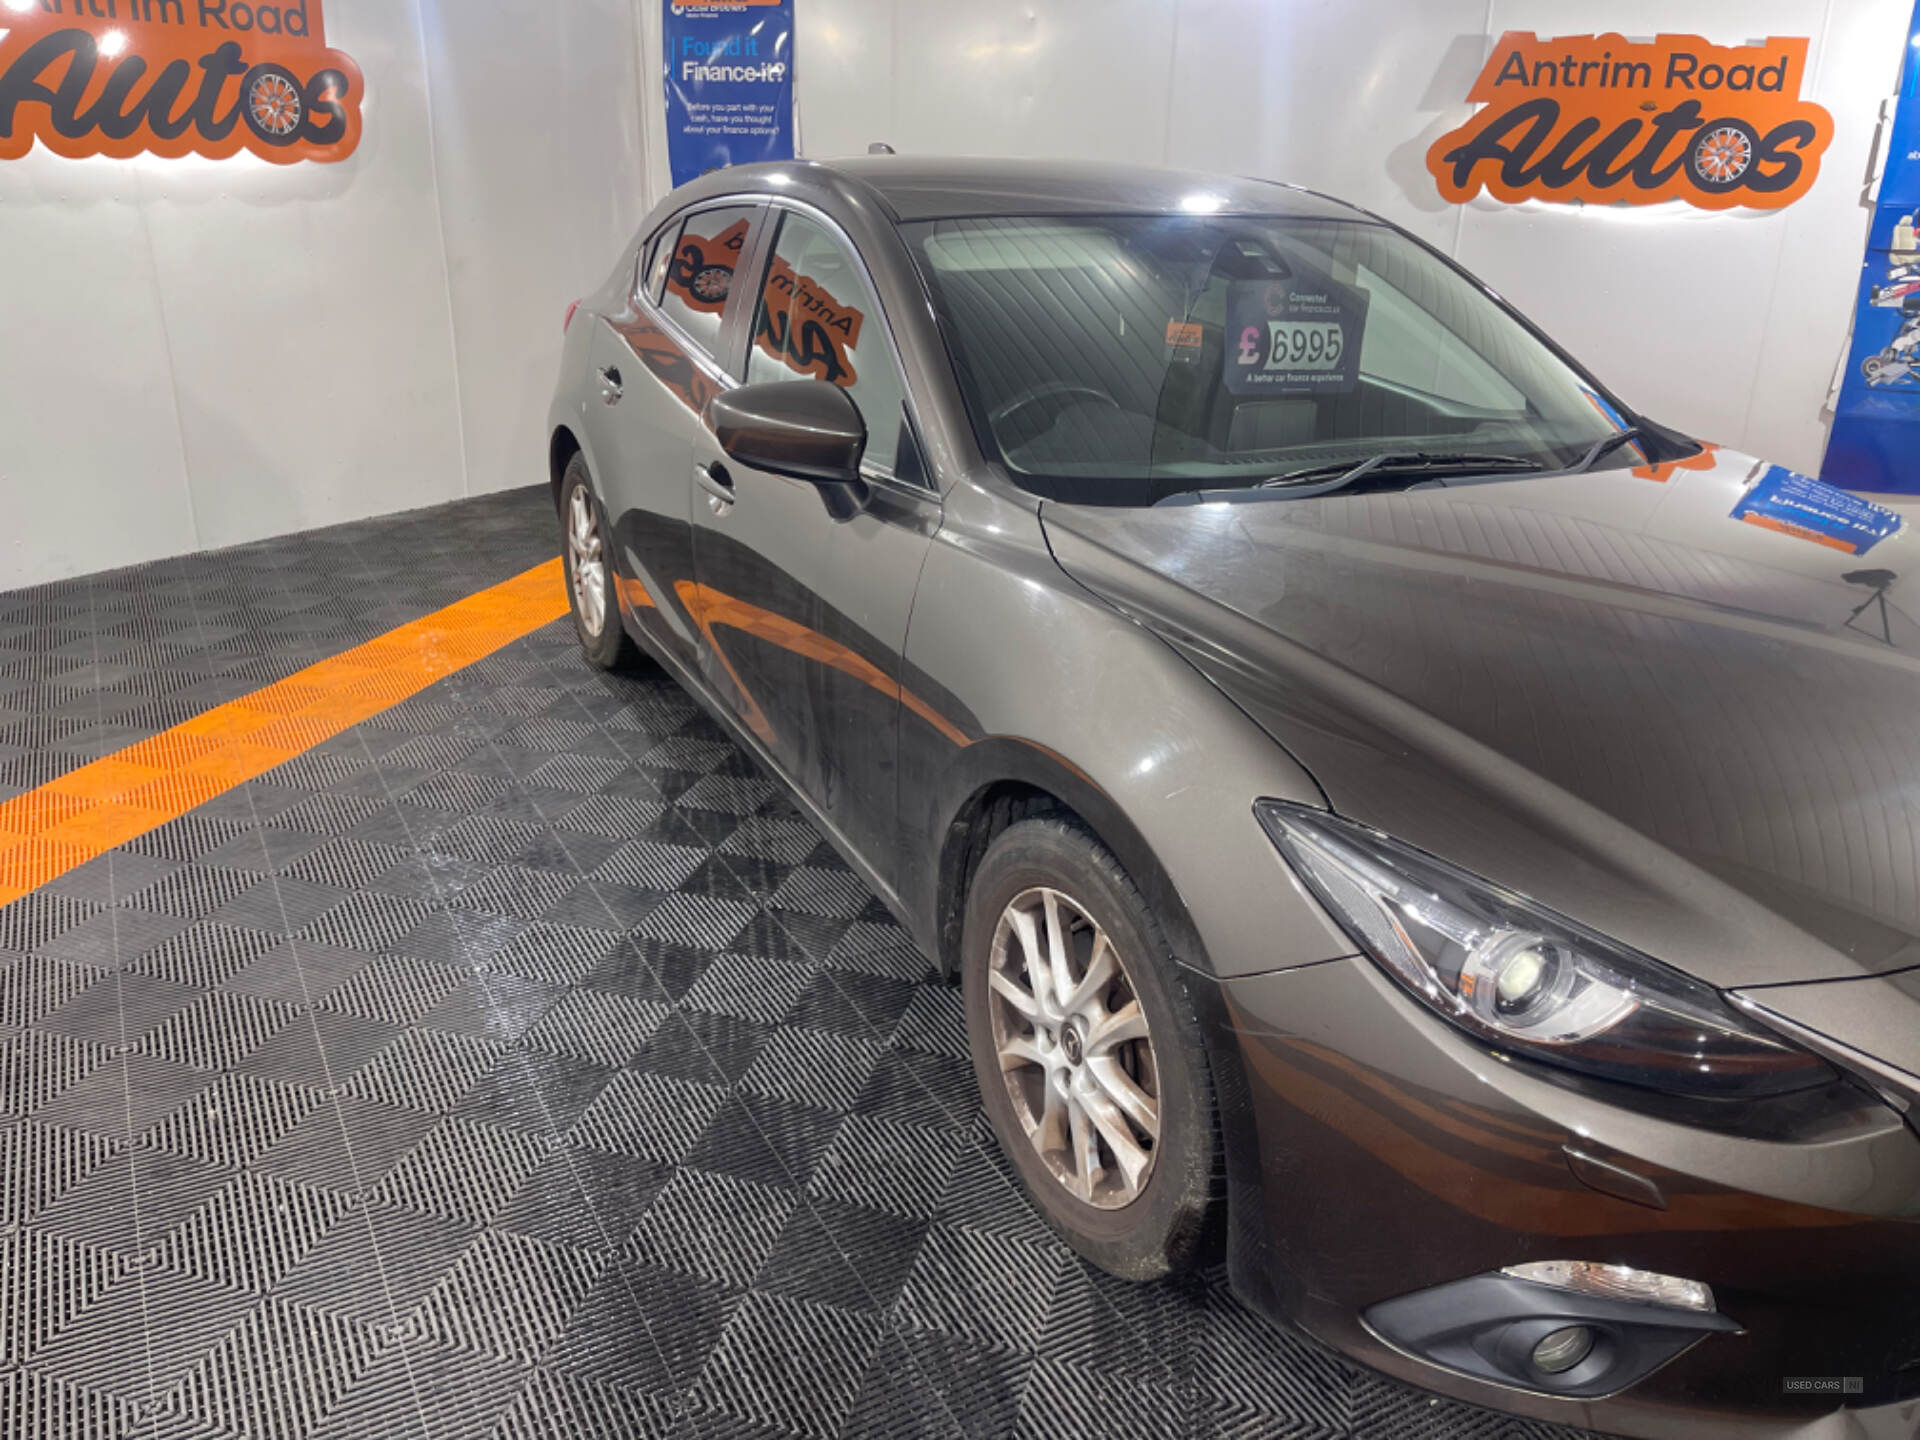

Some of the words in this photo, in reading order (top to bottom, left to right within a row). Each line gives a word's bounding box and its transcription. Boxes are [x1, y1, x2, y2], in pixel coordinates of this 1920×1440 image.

[200, 0, 309, 37] Road
[682, 35, 741, 57] Found
[745, 36, 758, 57] it
[0, 28, 349, 146] Autos
[1494, 51, 1651, 89] Antrim
[1664, 53, 1788, 92] Road
[1443, 97, 1816, 194] Autos
[1271, 329, 1341, 363] 6995
